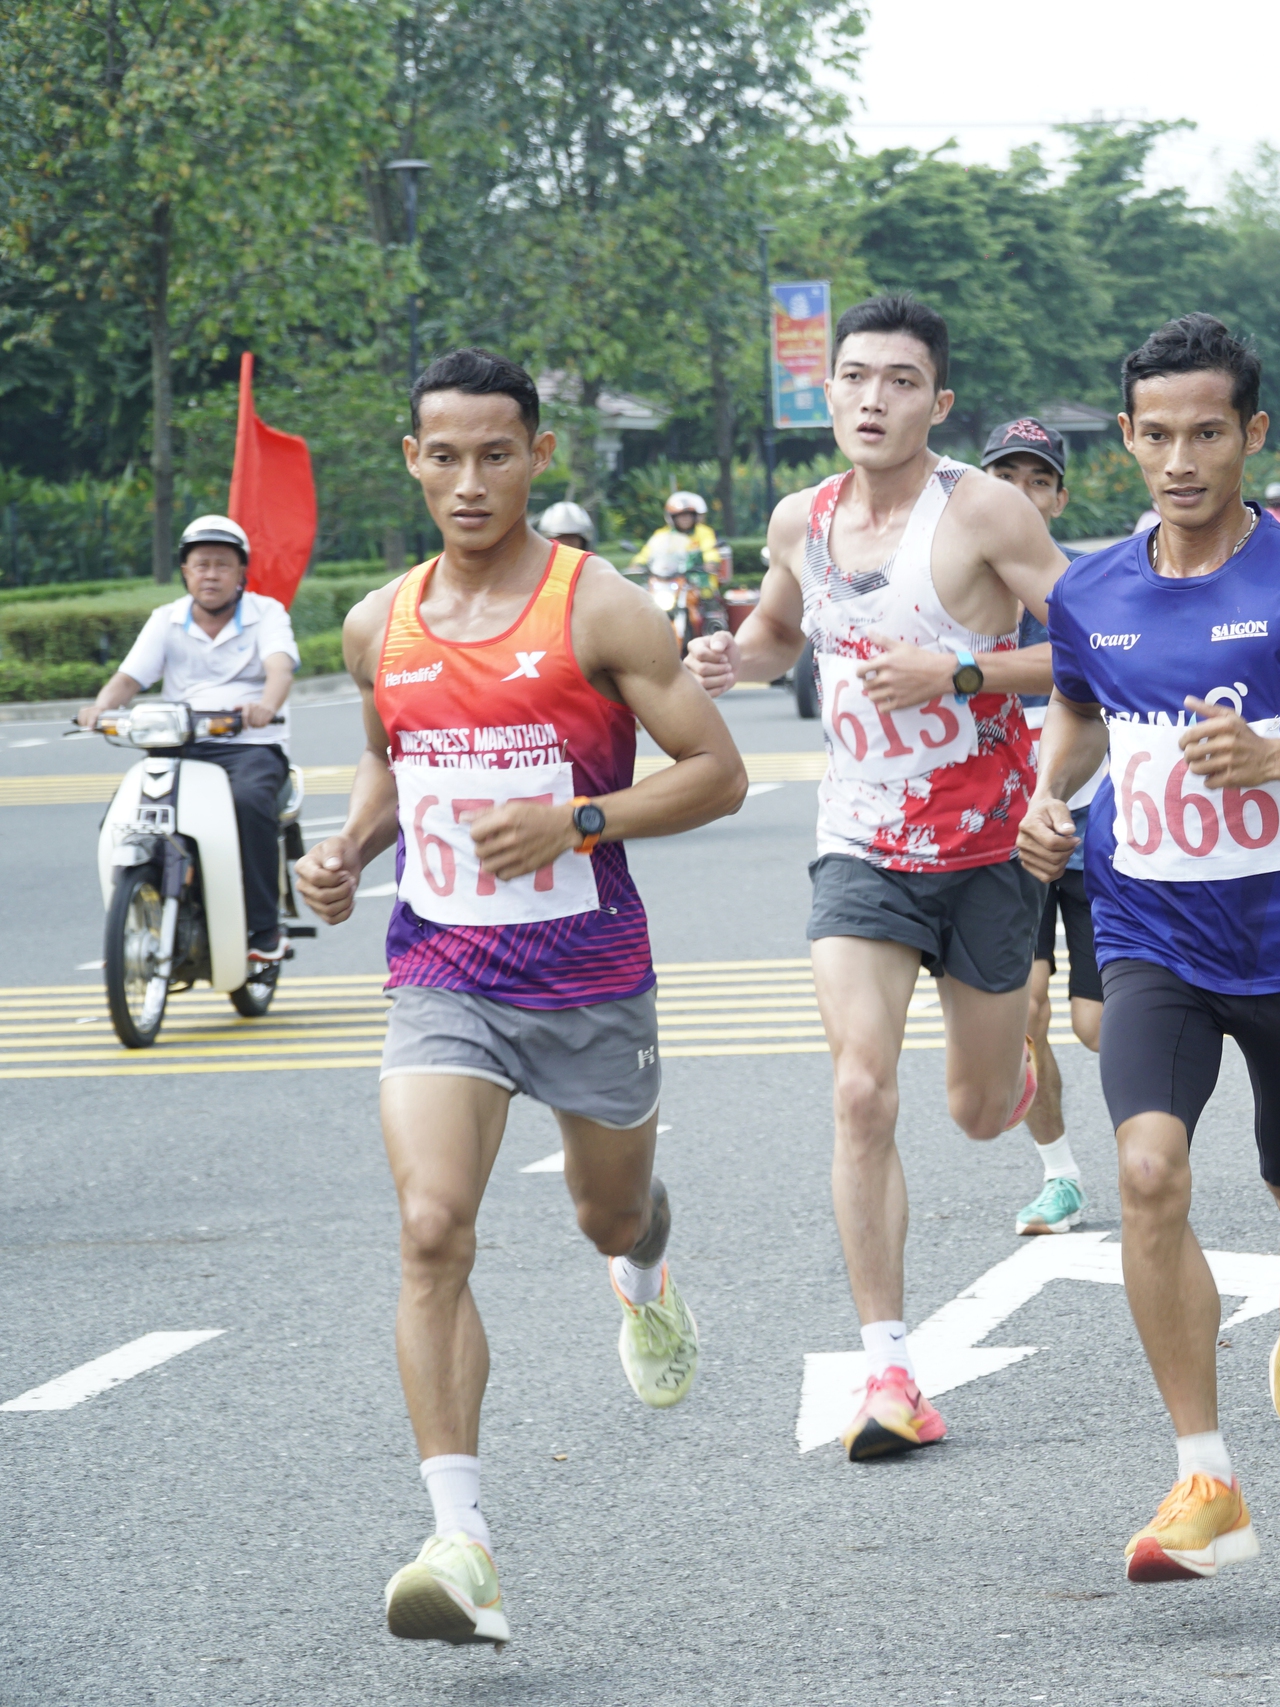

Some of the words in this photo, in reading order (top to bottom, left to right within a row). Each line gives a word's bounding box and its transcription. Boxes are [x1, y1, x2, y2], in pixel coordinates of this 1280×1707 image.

[1089, 632, 1142, 651] Ocany
[385, 664, 438, 688] Herbalife
[474, 724, 559, 751] MARATHON
[831, 680, 960, 762] 613
[1121, 751, 1280, 857] 666
[413, 793, 554, 897] 677
